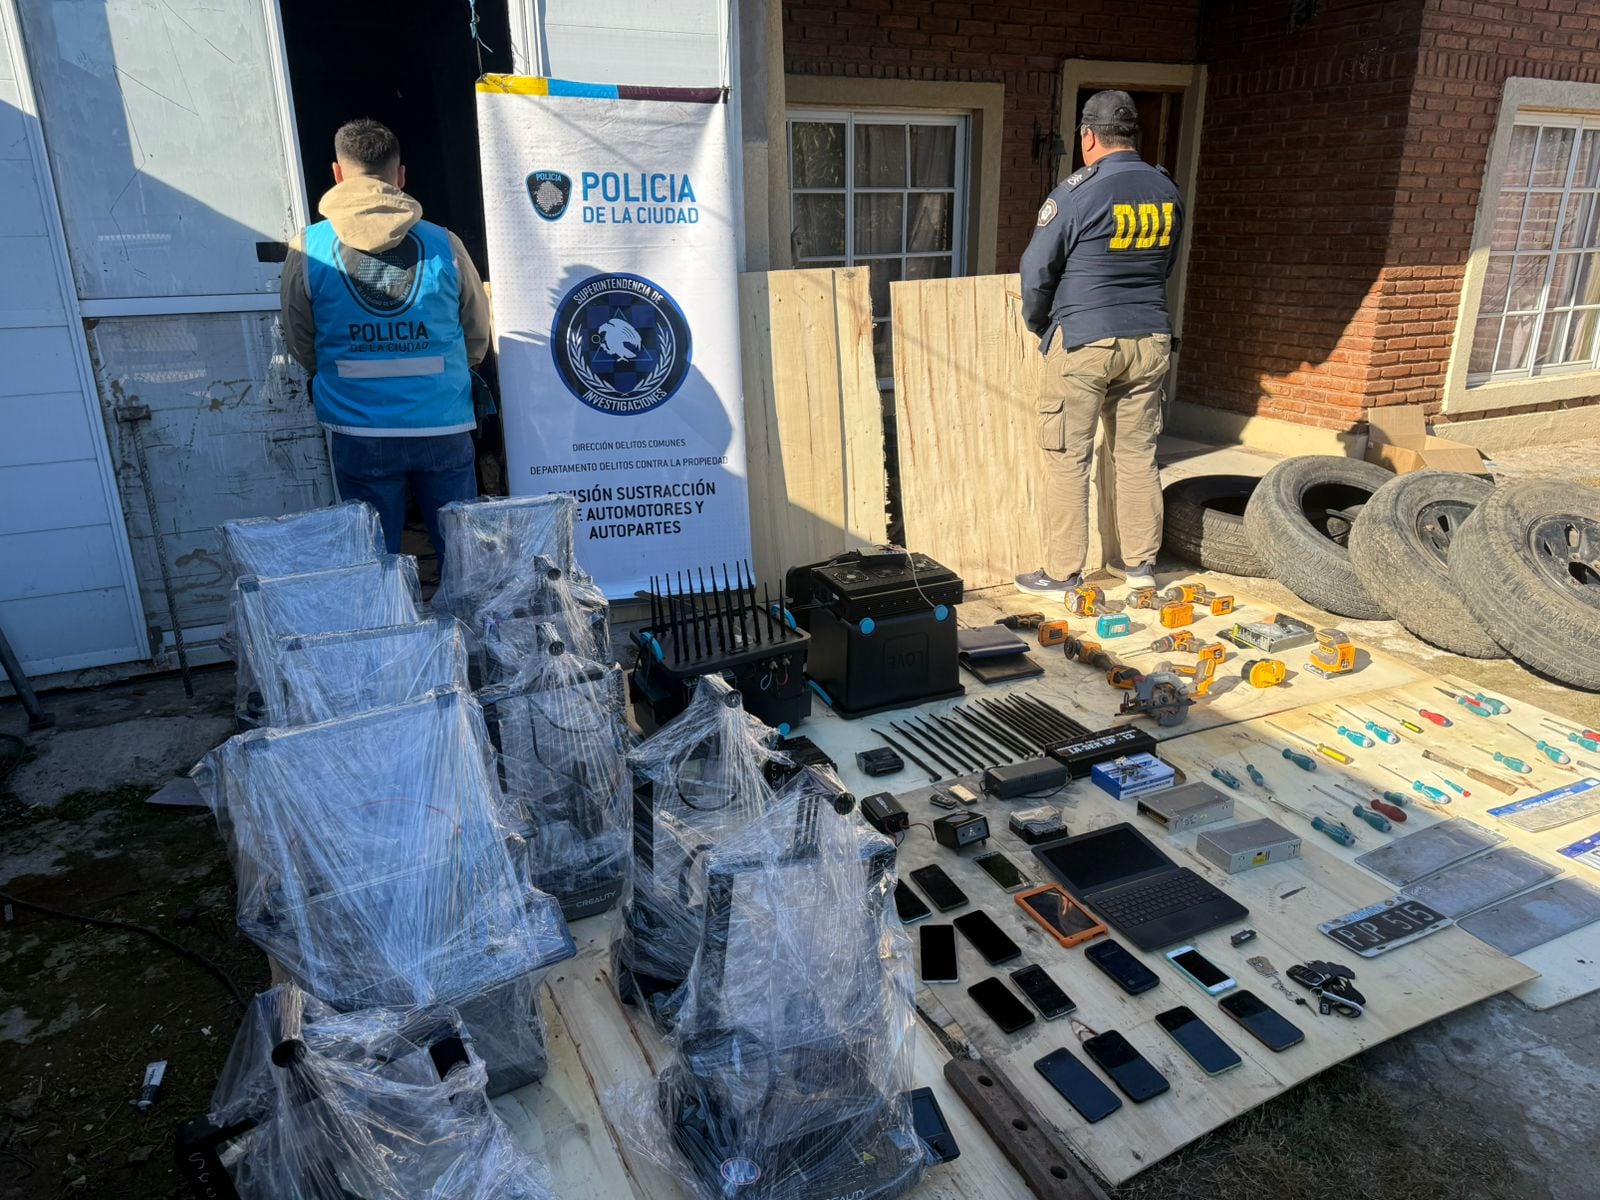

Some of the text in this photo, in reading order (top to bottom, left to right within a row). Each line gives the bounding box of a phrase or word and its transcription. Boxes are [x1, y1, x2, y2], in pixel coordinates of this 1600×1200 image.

[535, 172, 562, 182] POLICIA
[581, 171, 697, 203] POLICIA
[583, 206, 606, 223] DE
[611, 207, 632, 224] LA
[636, 207, 699, 224] CIUDAD
[1109, 202, 1174, 249] DDI
[573, 278, 664, 304] SUPERINTENDENCIA DE
[348, 321, 429, 342] POLICIA
[350, 341, 430, 353] DE LA CIUDAD
[582, 387, 668, 411] INVESTIGACIONES
[572, 438, 687, 452] DIRECCIÓN DELITOS COMUNES
[530, 456, 728, 475] DEPARTAMENTO DELITOS CONTRA LA PROPIEDAD
[616, 479, 716, 501] SUSTRACCIÓN
[586, 502, 692, 521] AUTOMOTORES
[697, 501, 704, 514] Y
[589, 521, 681, 539] AUTOPARTES
[575, 890, 616, 908] CREALITY
[1382, 904, 1434, 930] 515
